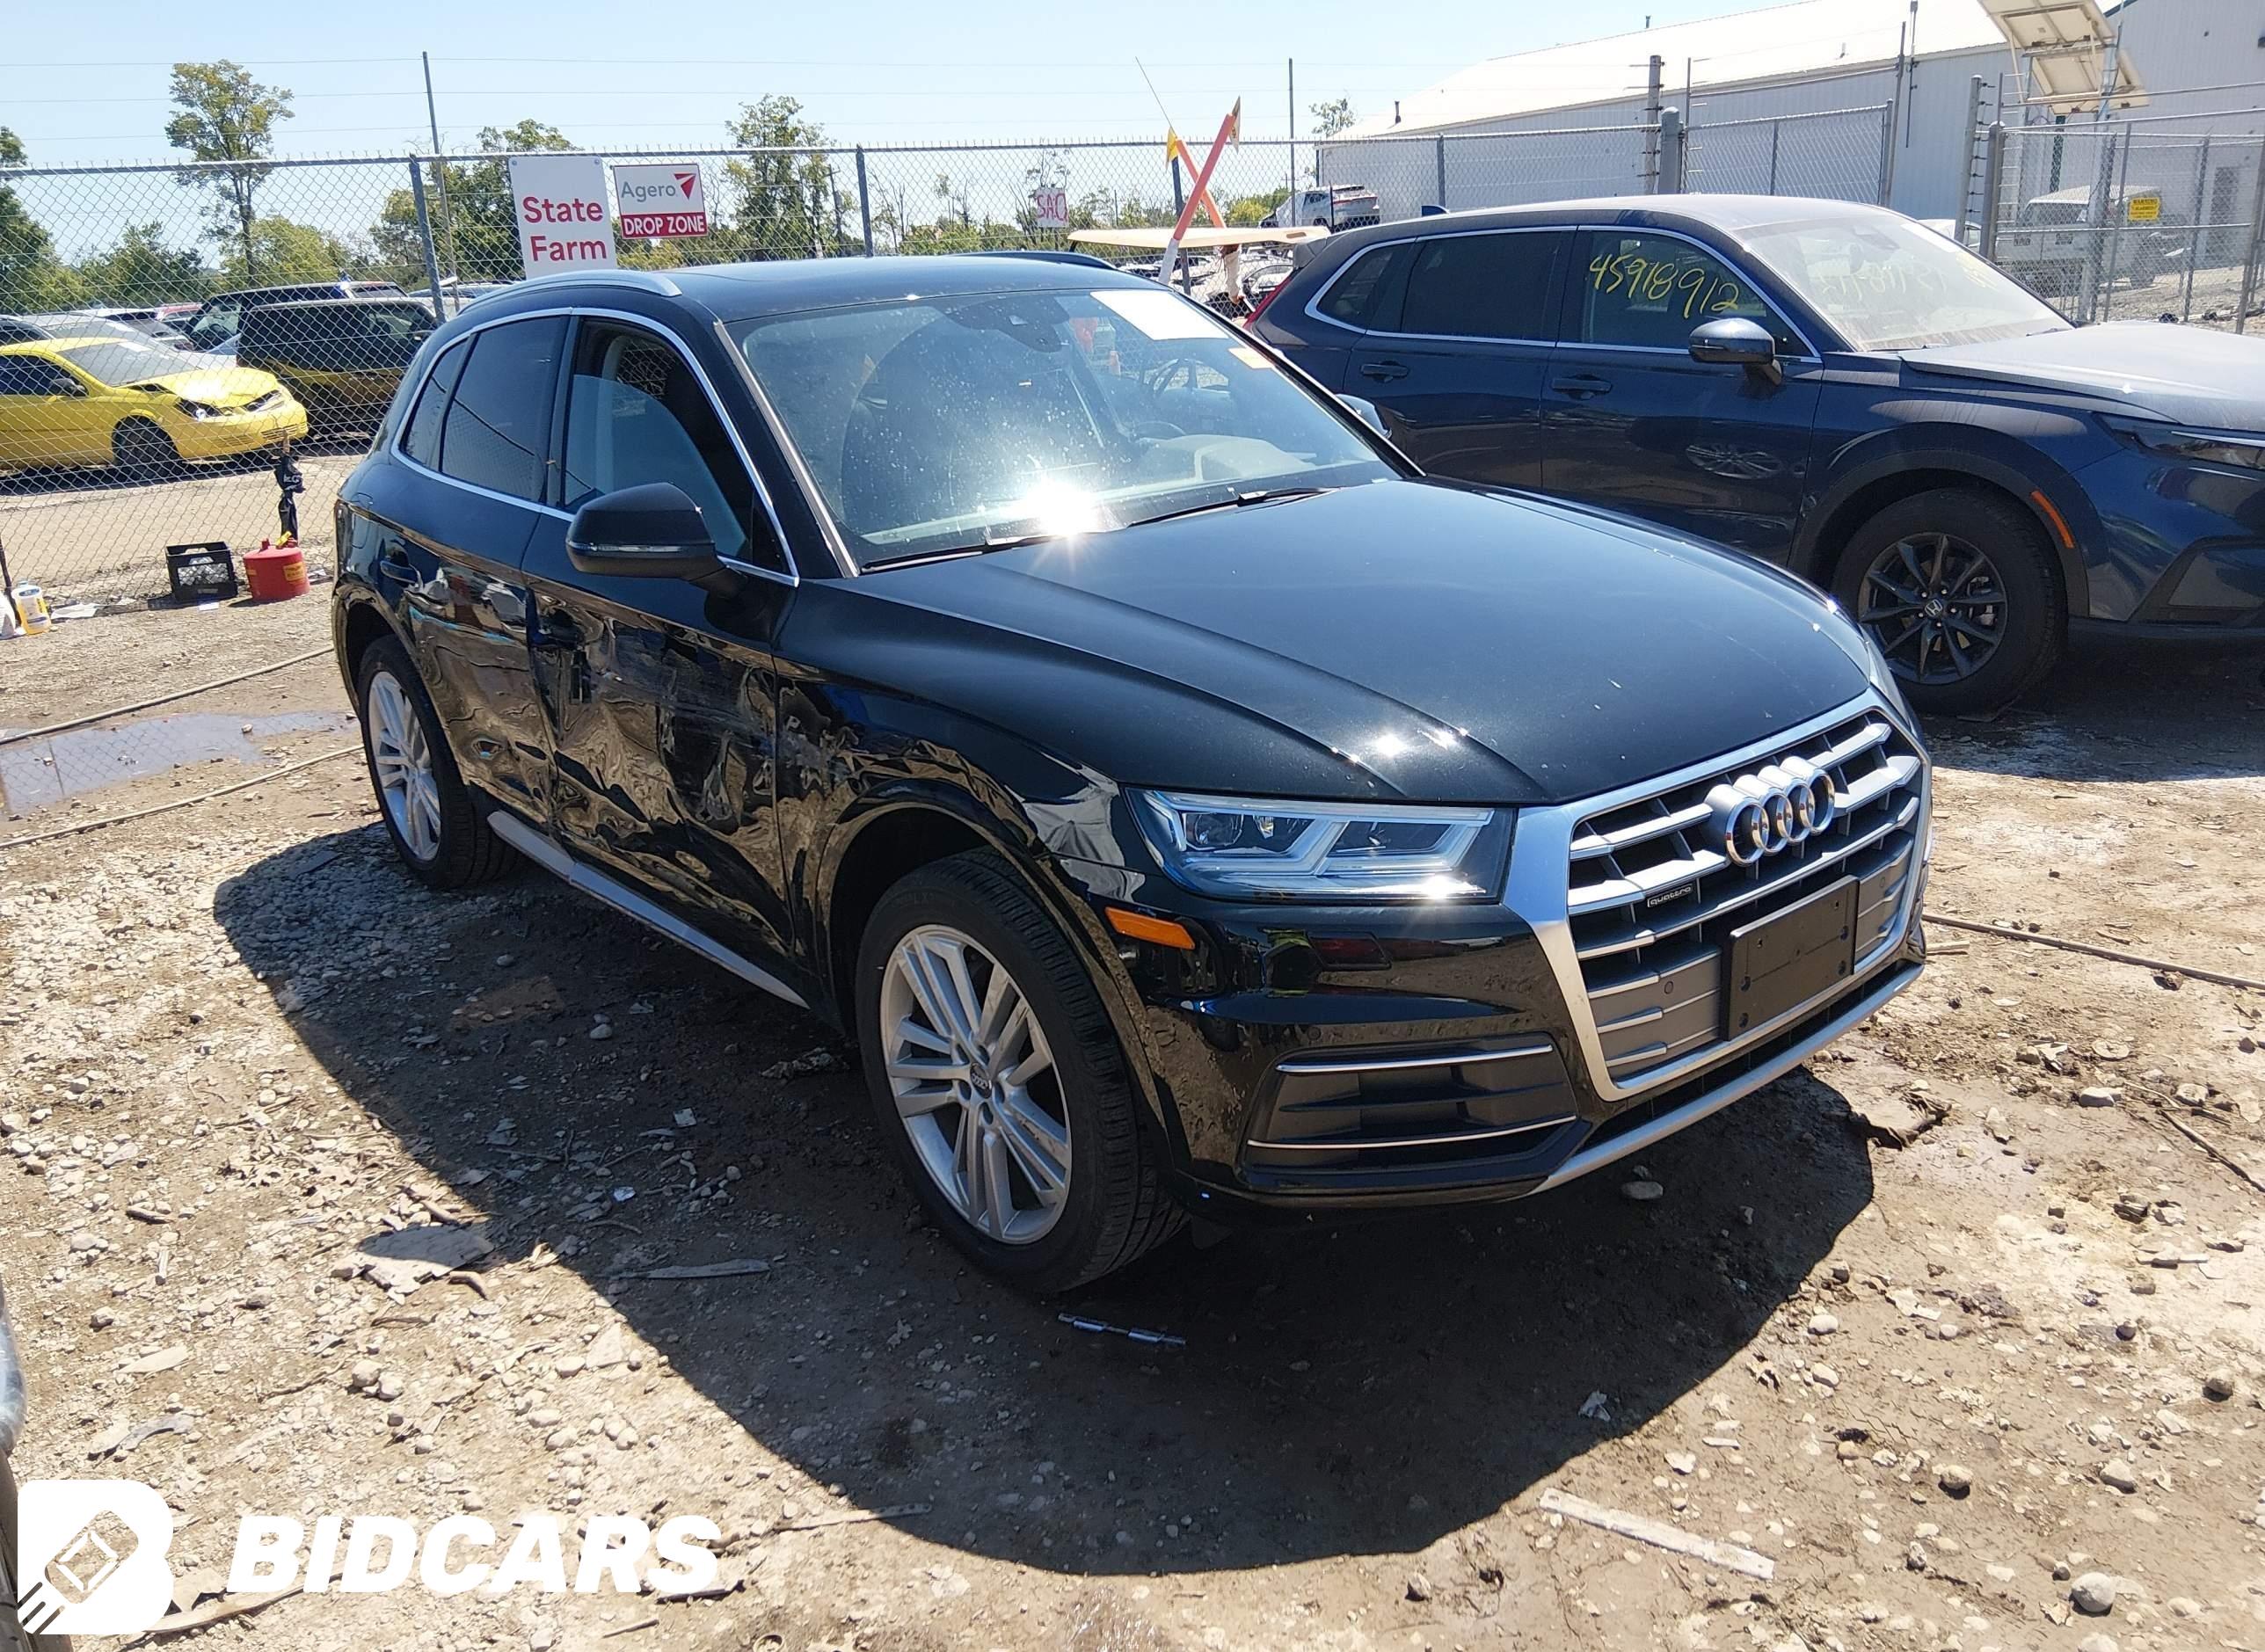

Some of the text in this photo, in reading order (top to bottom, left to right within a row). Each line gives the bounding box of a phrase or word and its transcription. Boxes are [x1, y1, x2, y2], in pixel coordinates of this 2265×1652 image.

[621, 181, 676, 202] Agero
[522, 197, 603, 223] State
[623, 215, 705, 236] DROP ZONE
[530, 235, 607, 262] Farm
[1589, 254, 1739, 318] 45918912
[1650, 886, 1691, 906] quattro
